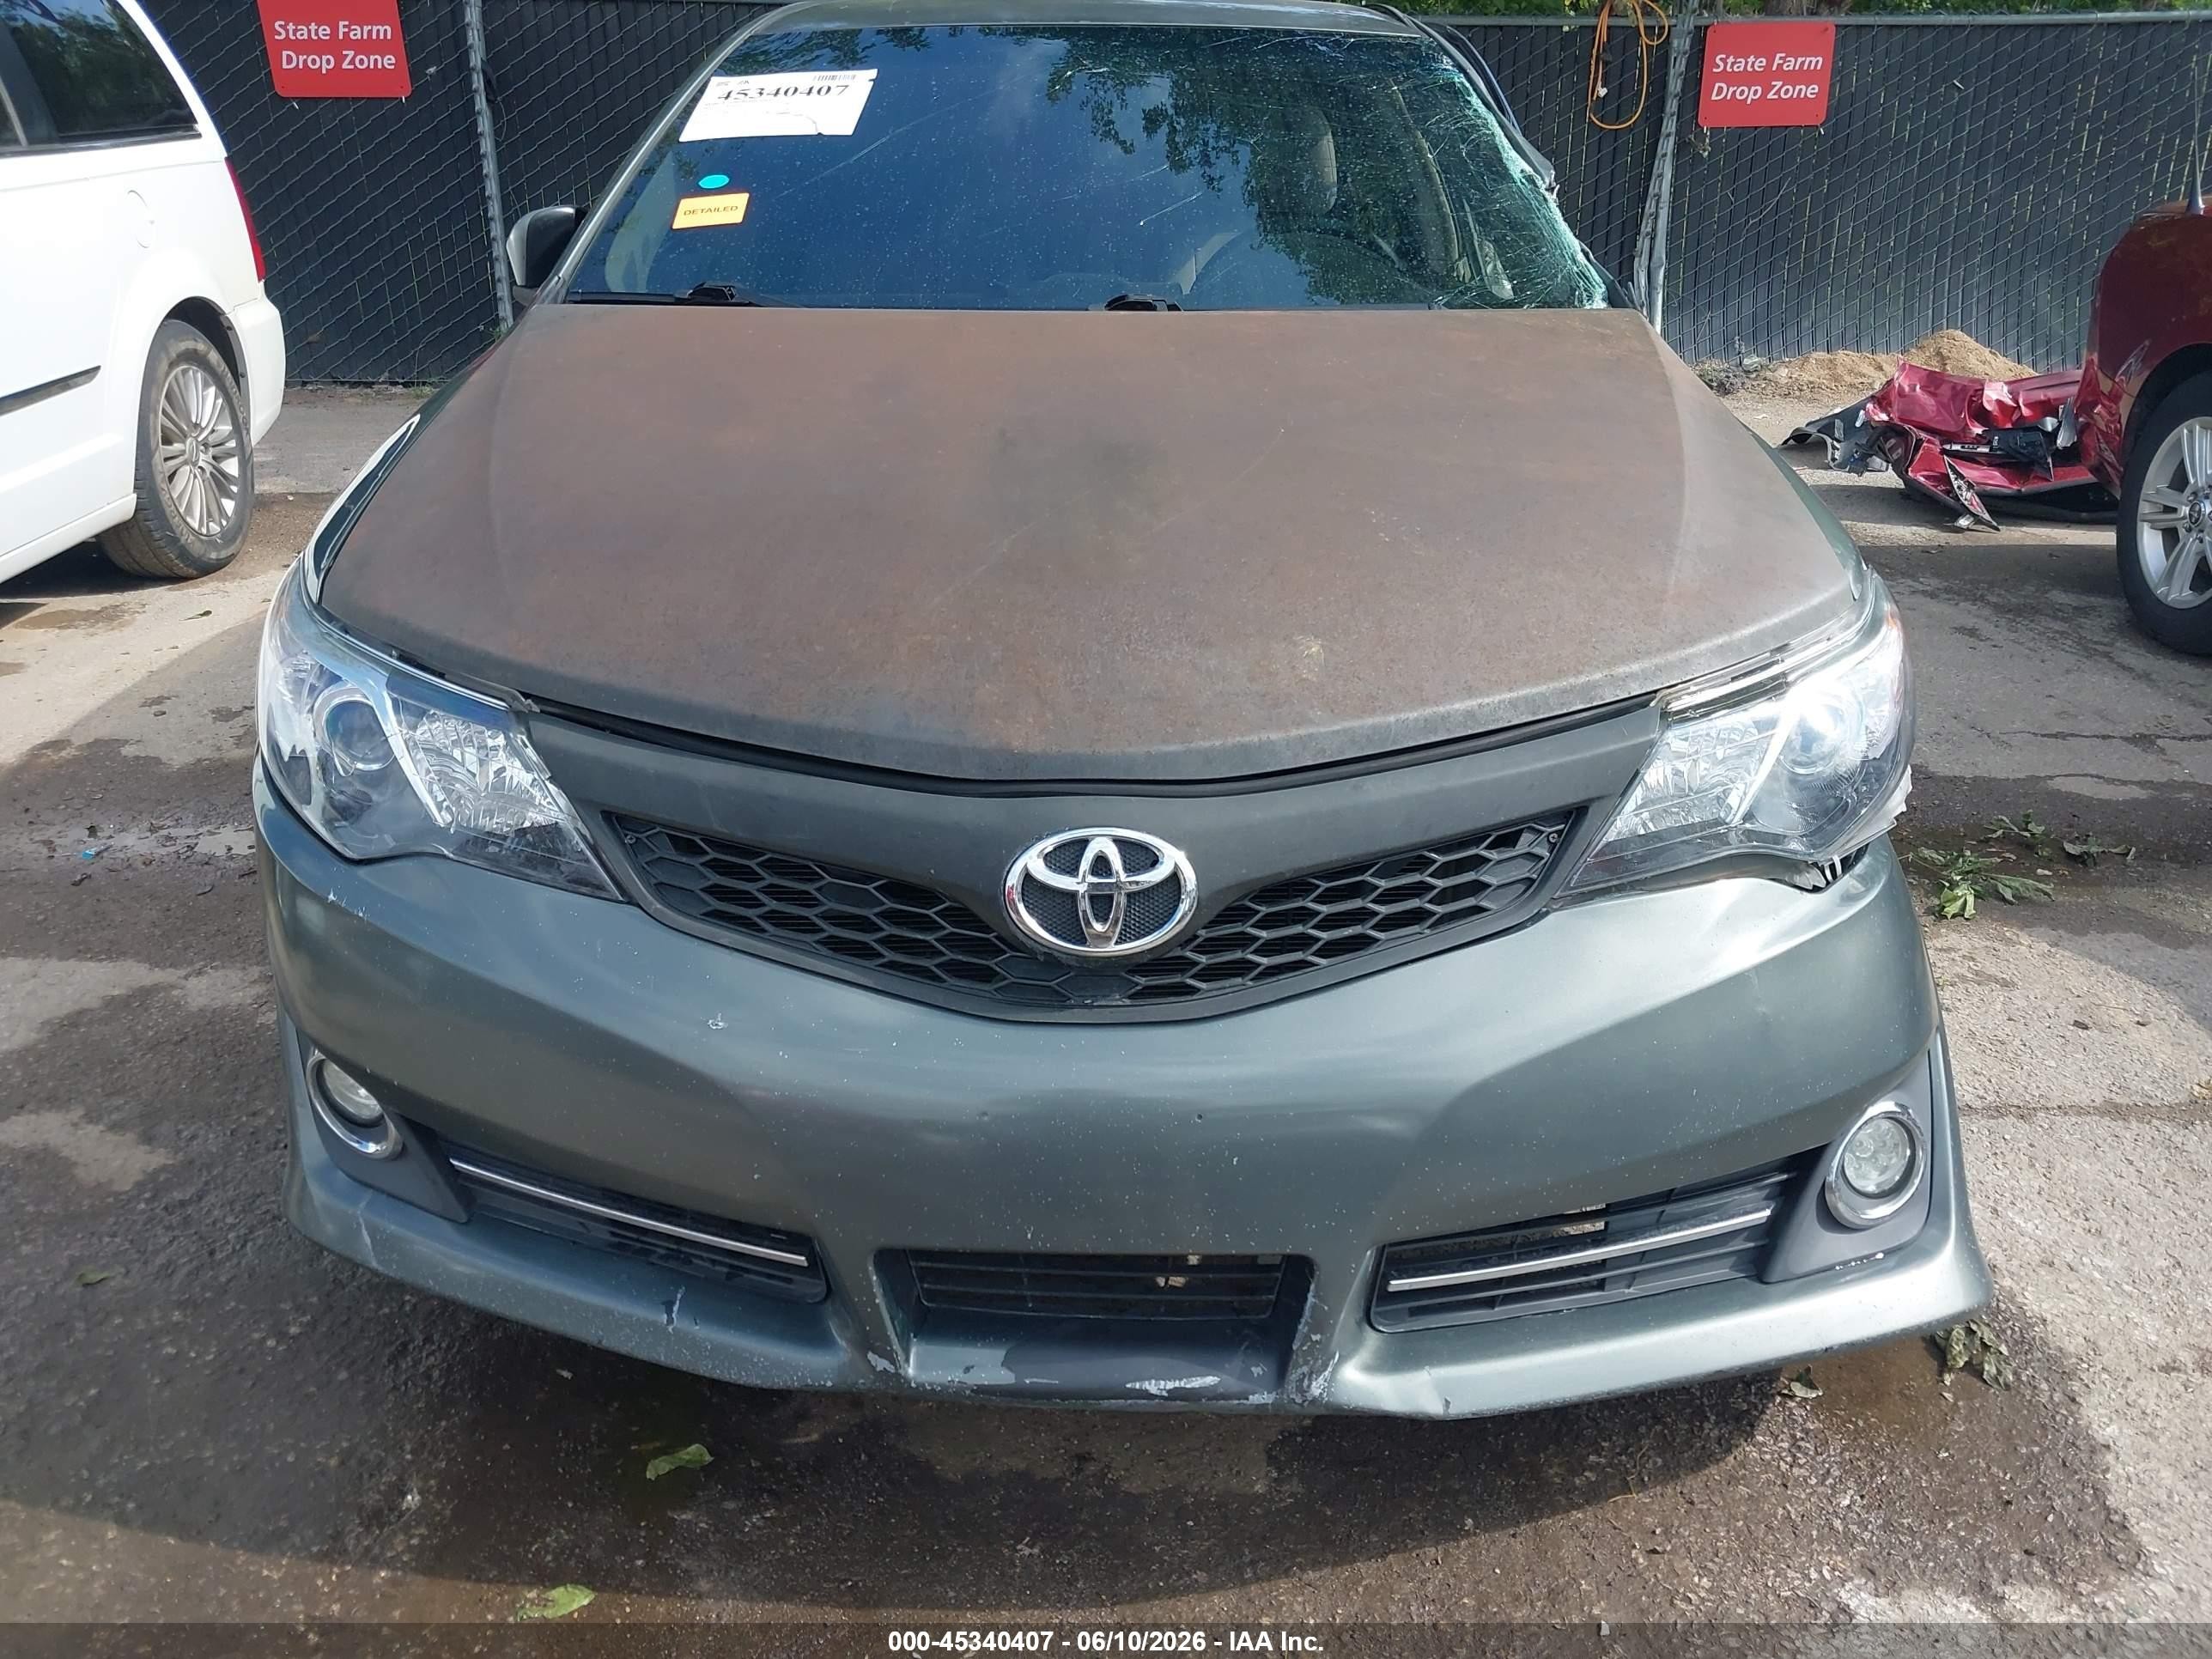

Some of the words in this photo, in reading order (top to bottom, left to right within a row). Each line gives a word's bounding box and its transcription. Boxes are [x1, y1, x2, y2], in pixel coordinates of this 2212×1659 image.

[274, 21, 331, 40] State
[338, 21, 392, 40] Farm
[282, 50, 335, 75] Drop
[342, 50, 396, 70] Zone
[1712, 54, 1766, 73] State
[1771, 52, 1823, 71] Farm
[717, 84, 851, 101] 45340407
[1711, 82, 1762, 105] Drop
[1766, 81, 1819, 100] Zone
[683, 205, 738, 216] DETAILED
